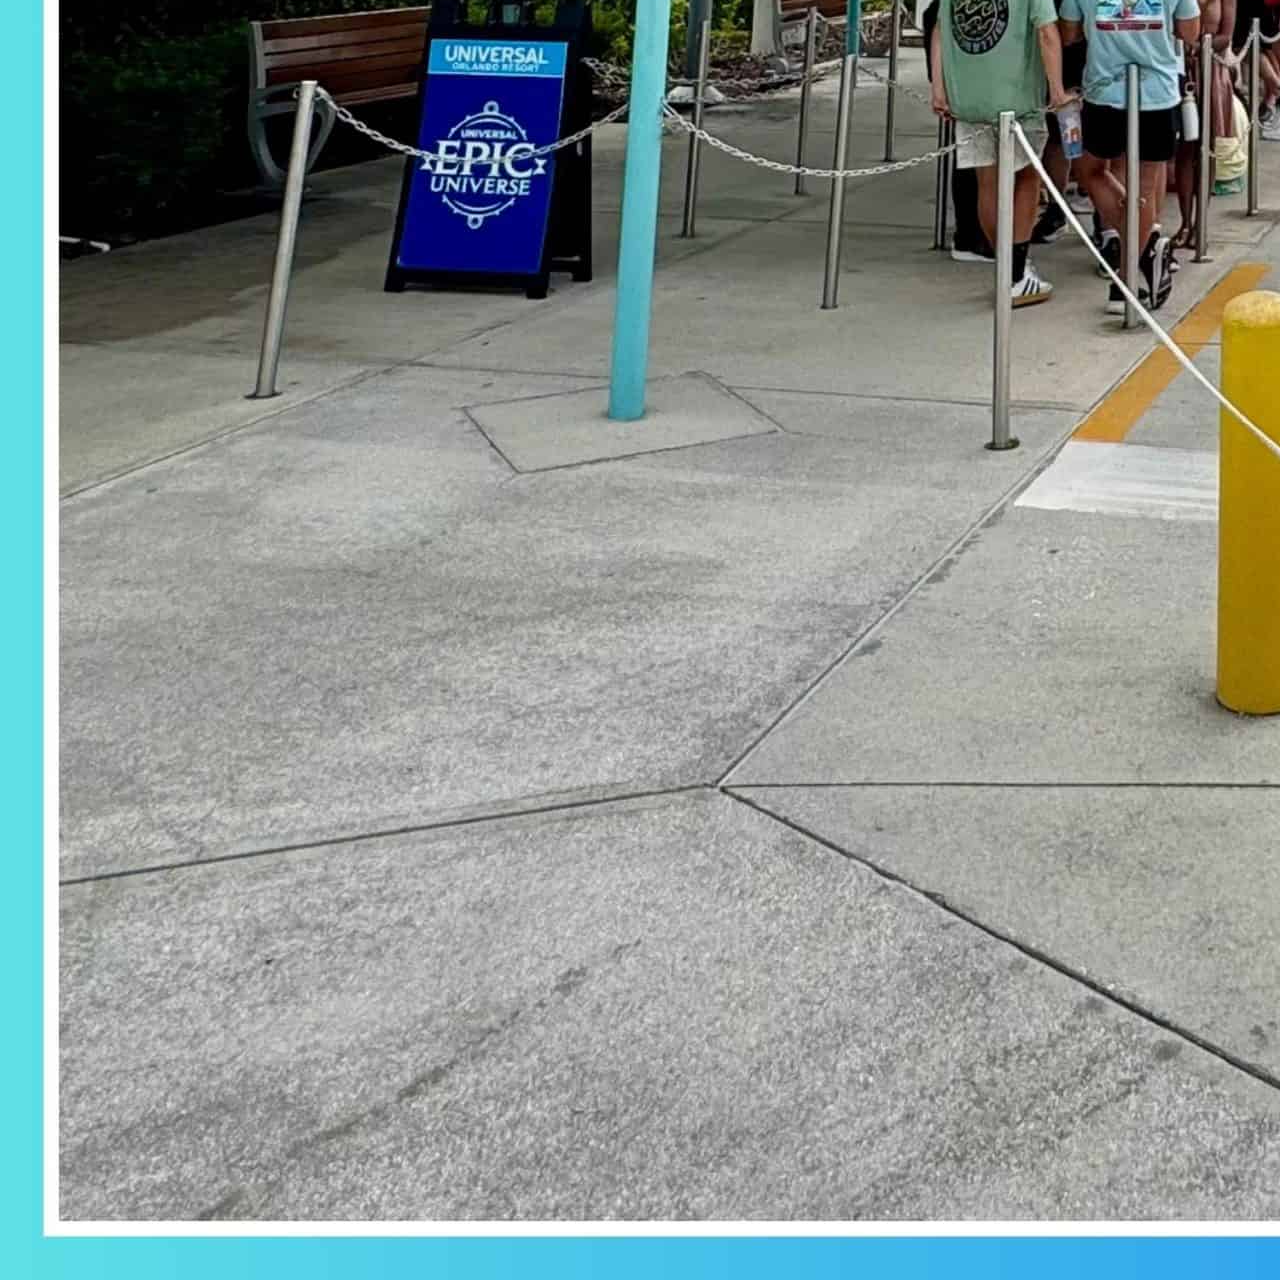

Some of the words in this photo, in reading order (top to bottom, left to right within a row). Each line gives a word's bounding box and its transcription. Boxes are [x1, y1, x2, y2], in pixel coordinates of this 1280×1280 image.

[444, 45, 549, 65] UNIVERSAL
[452, 62, 499, 71] ORLANDO
[501, 63, 540, 72] RESORT
[460, 129, 518, 140] UNIVERSAL
[432, 139, 535, 178] EPIC
[430, 176, 531, 195] UNIVERSE
